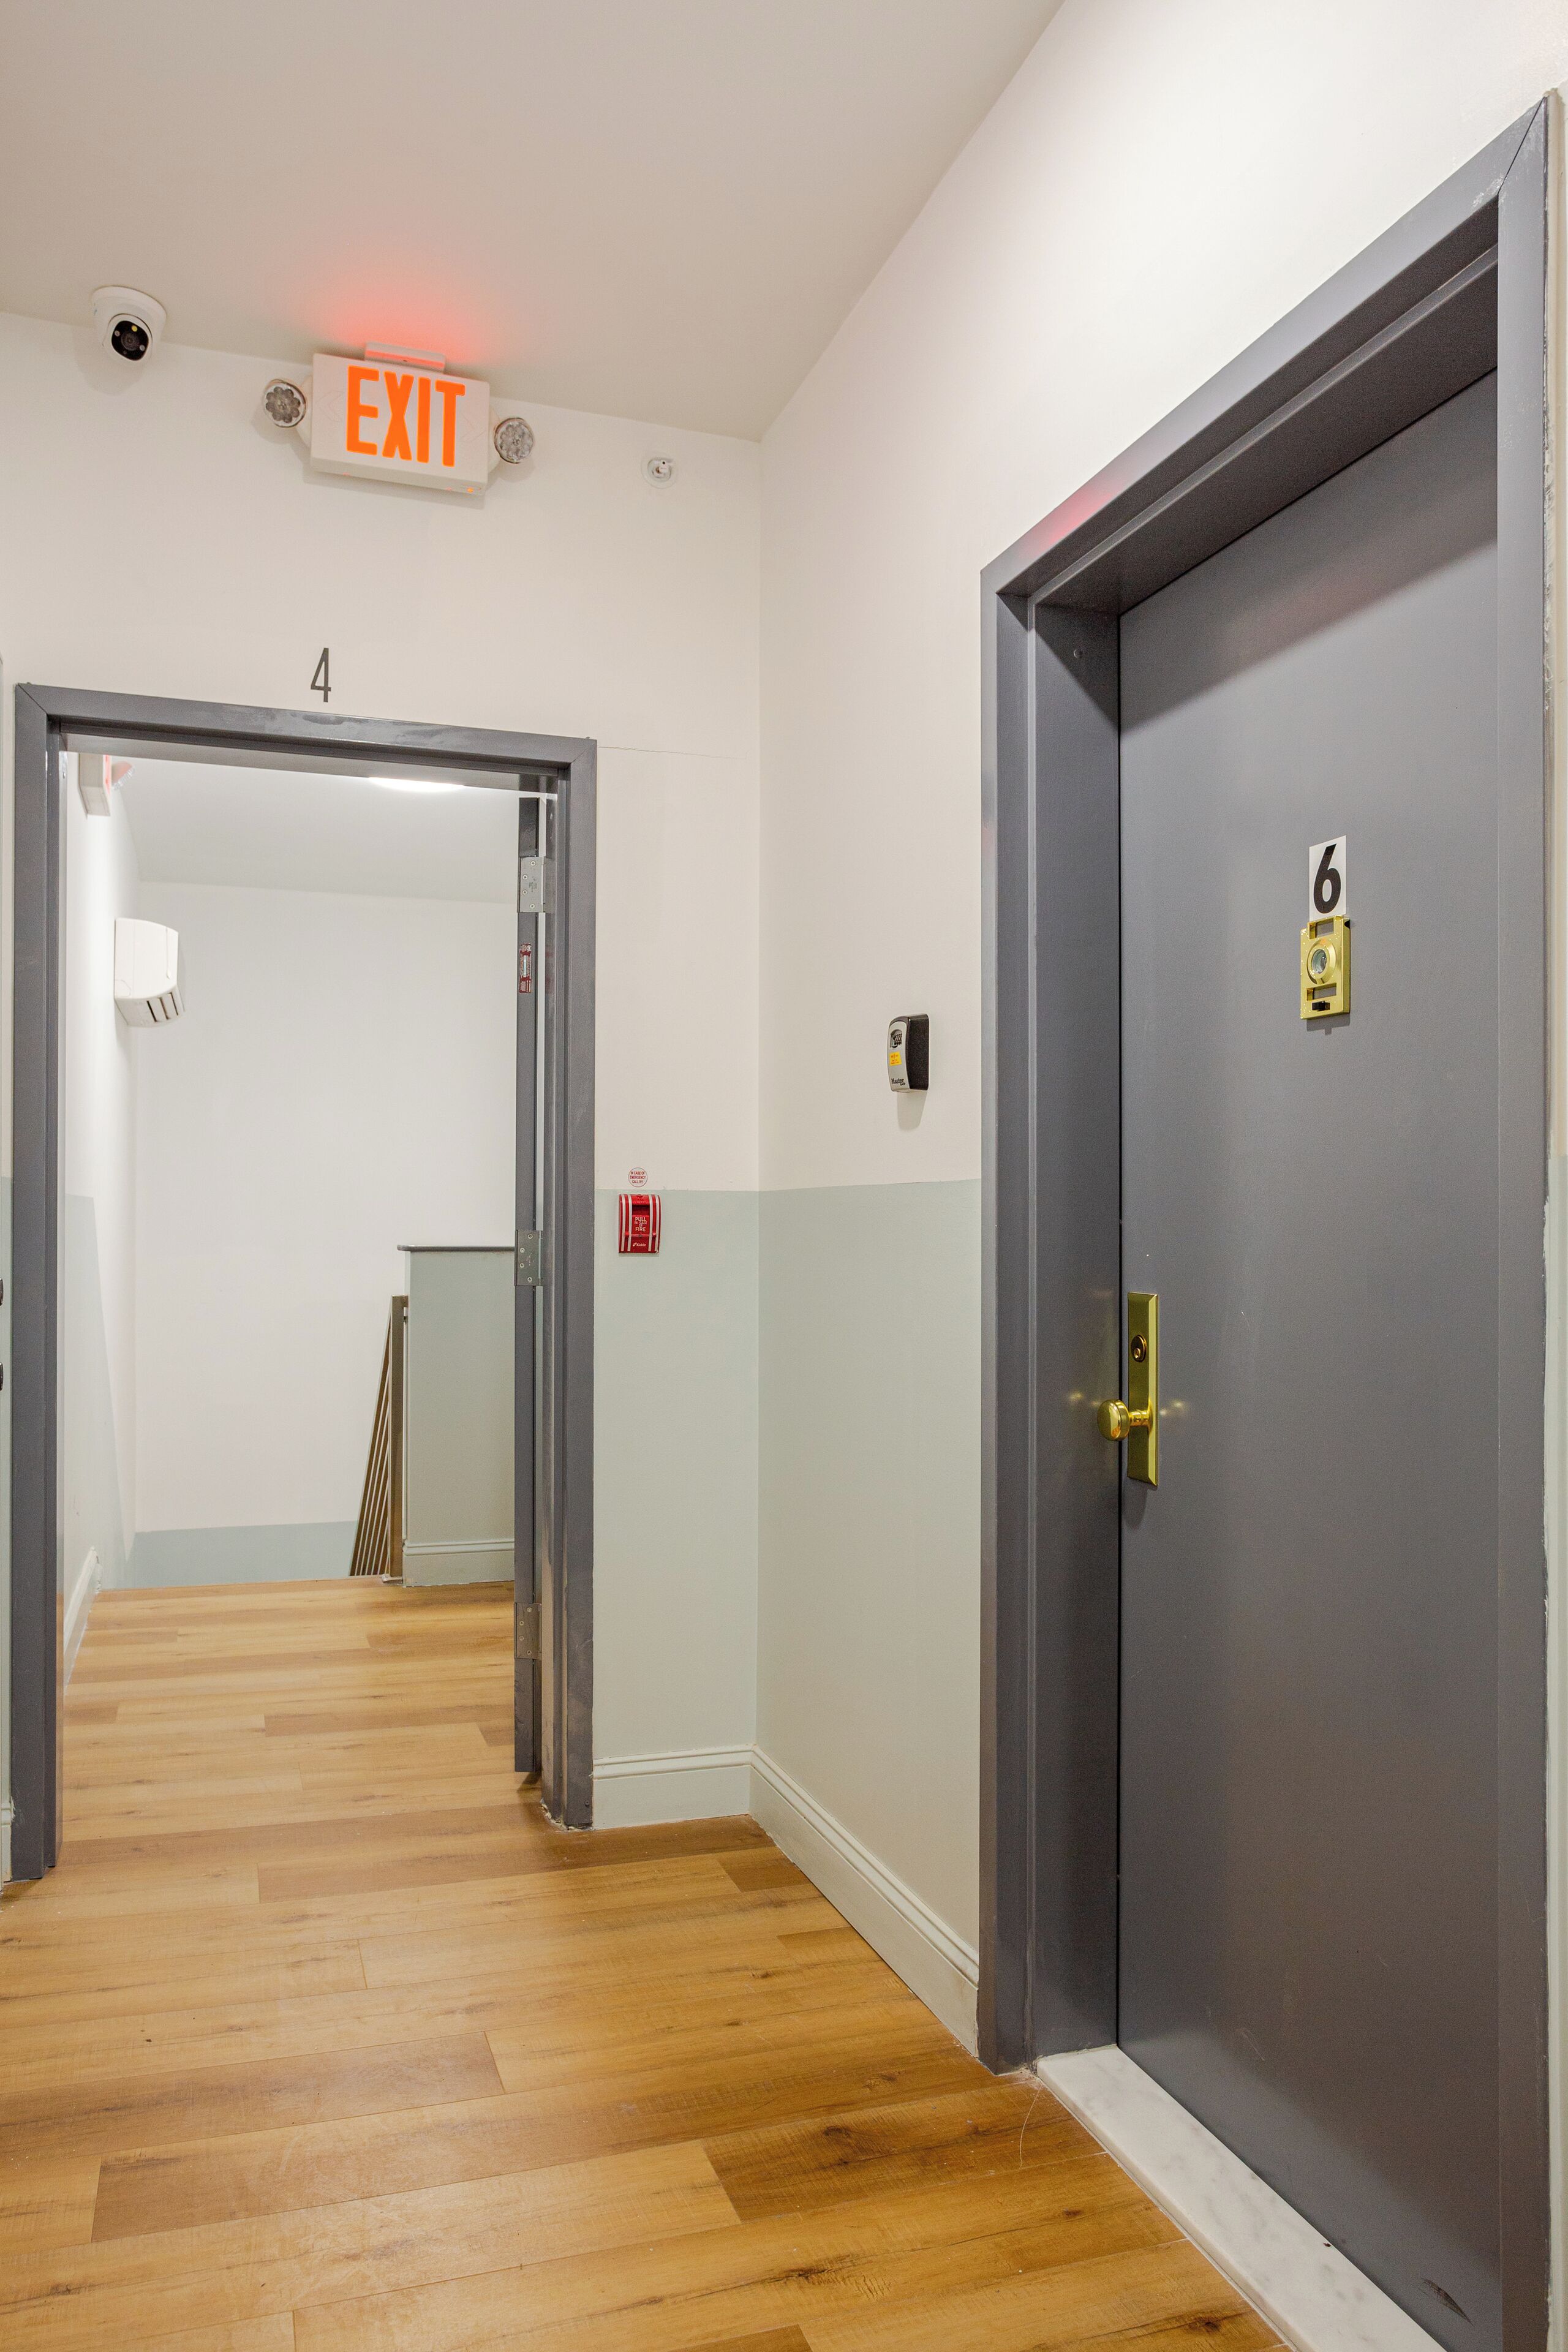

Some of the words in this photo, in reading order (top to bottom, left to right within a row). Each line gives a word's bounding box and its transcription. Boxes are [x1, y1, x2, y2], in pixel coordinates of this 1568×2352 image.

[346, 365, 466, 467] EXIT
[311, 647, 331, 703] 4
[1313, 843, 1341, 914] 6
